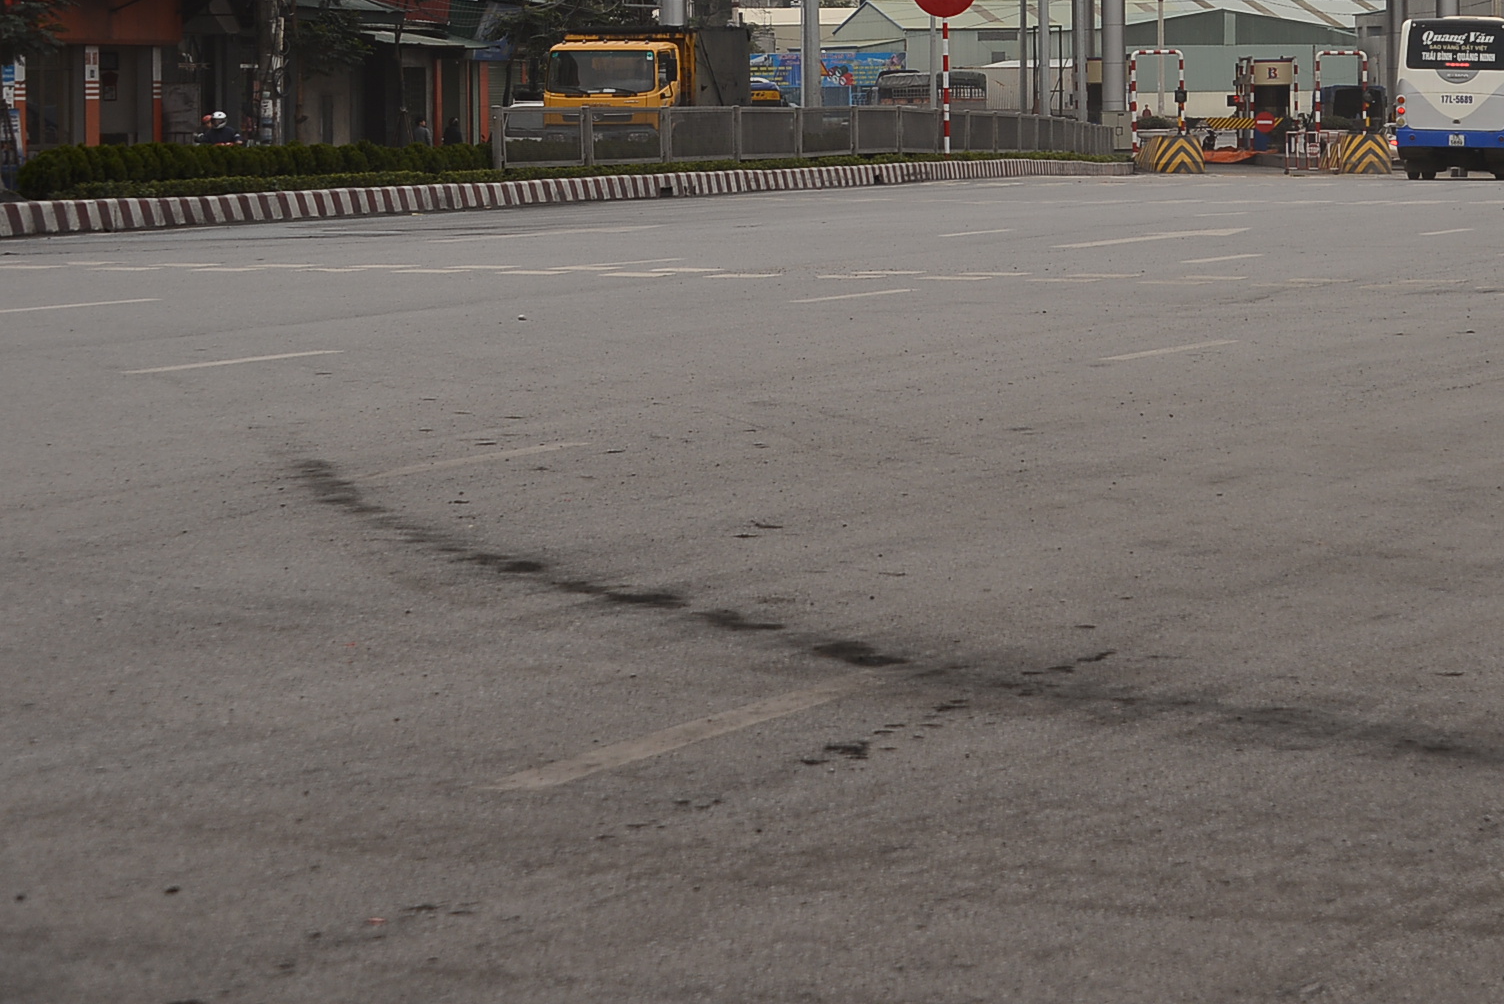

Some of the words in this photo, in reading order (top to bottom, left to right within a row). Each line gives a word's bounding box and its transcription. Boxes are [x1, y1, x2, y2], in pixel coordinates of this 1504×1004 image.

[1421, 51, 1436, 61] THÁI
[1436, 51, 1453, 61] BÌNH
[1456, 50, 1479, 62] QUẢNG
[1441, 95, 1473, 104] 17L-5689
